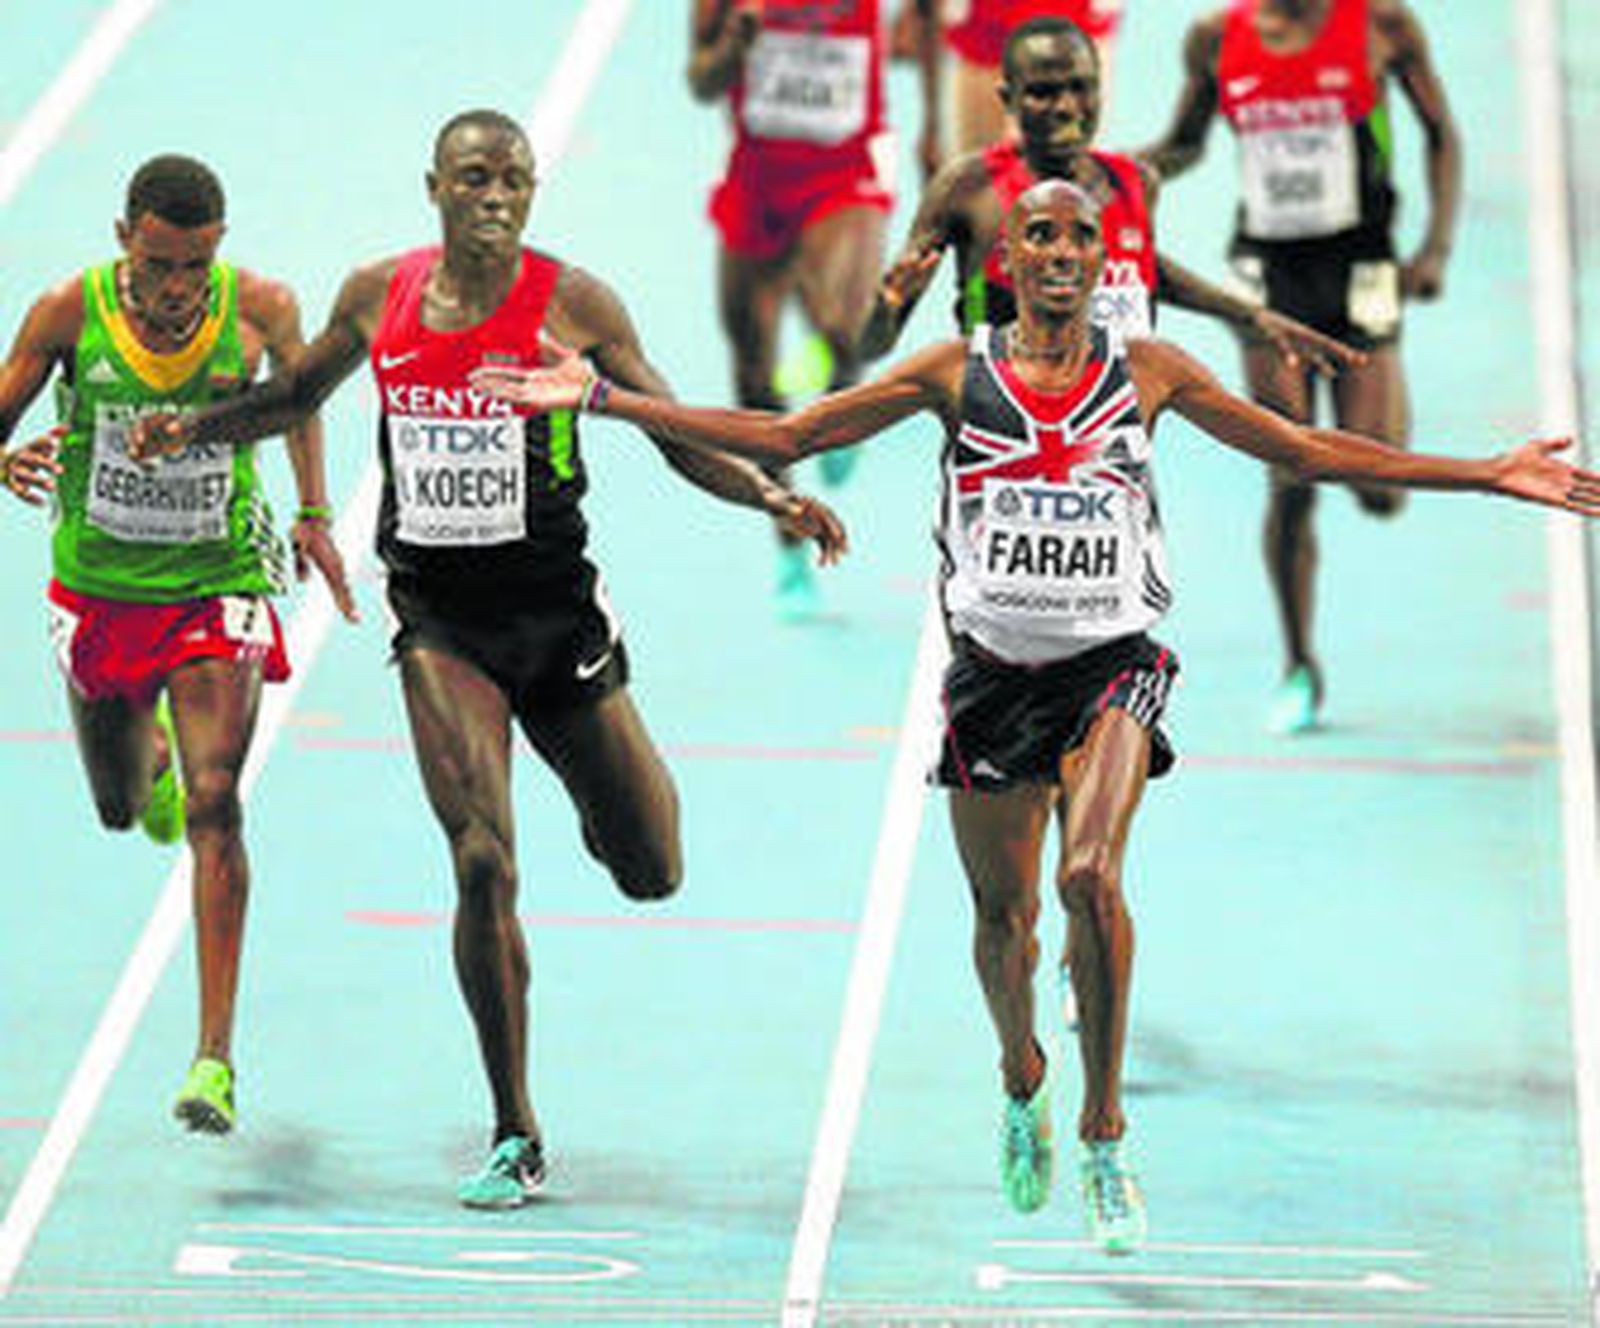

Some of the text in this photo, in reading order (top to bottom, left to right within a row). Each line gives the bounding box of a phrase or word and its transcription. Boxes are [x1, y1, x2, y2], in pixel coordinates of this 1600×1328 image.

[386, 384, 513, 418] KENYA
[419, 424, 507, 454] TDK
[414, 466, 518, 509] KOECH
[1022, 488, 1115, 521] TDK
[987, 530, 1119, 579] FARAH
